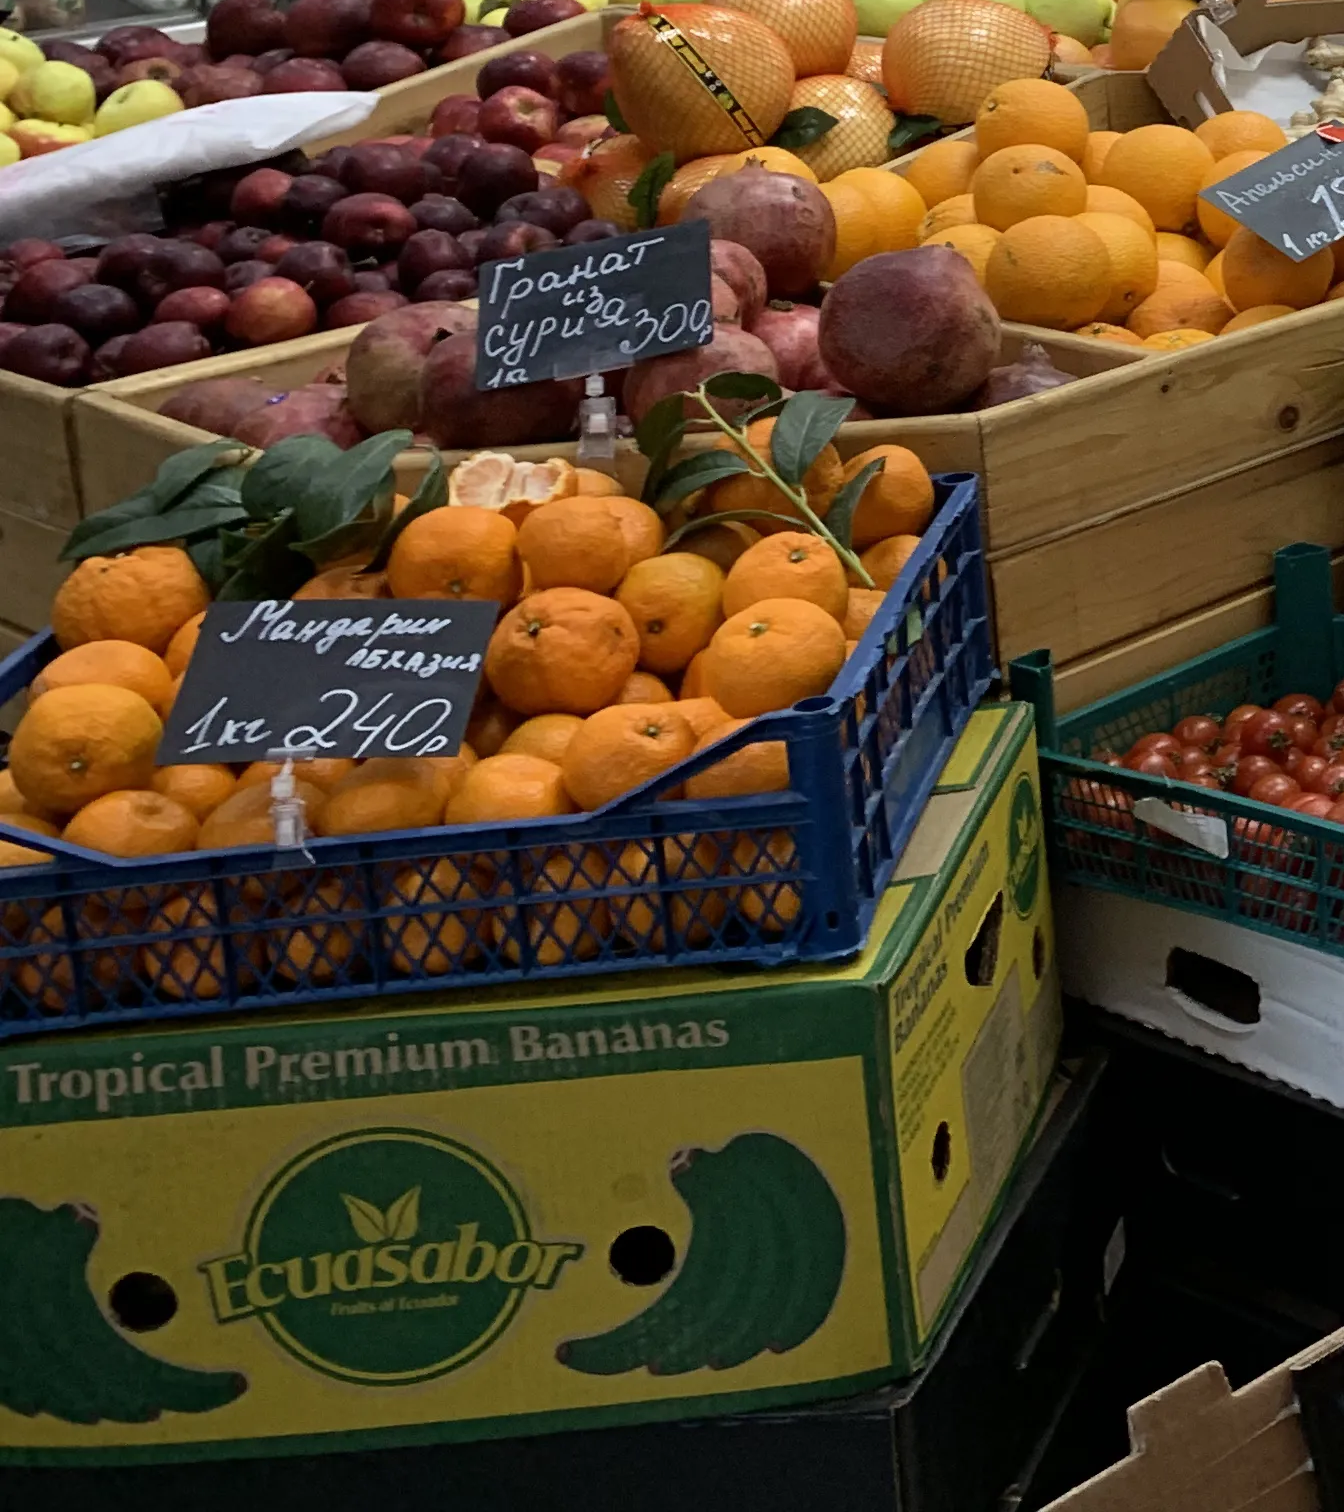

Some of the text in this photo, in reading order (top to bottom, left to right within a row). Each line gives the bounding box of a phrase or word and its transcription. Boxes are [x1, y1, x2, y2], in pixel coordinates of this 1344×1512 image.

[488, 236, 665, 320] Гранат
[220, 599, 452, 657] Мандарин
[183, 688, 452, 759] 1кг 240р
[8, 1014, 732, 1110] Tropical Premium Bananas
[208, 1221, 582, 1323] Ecuasabor
